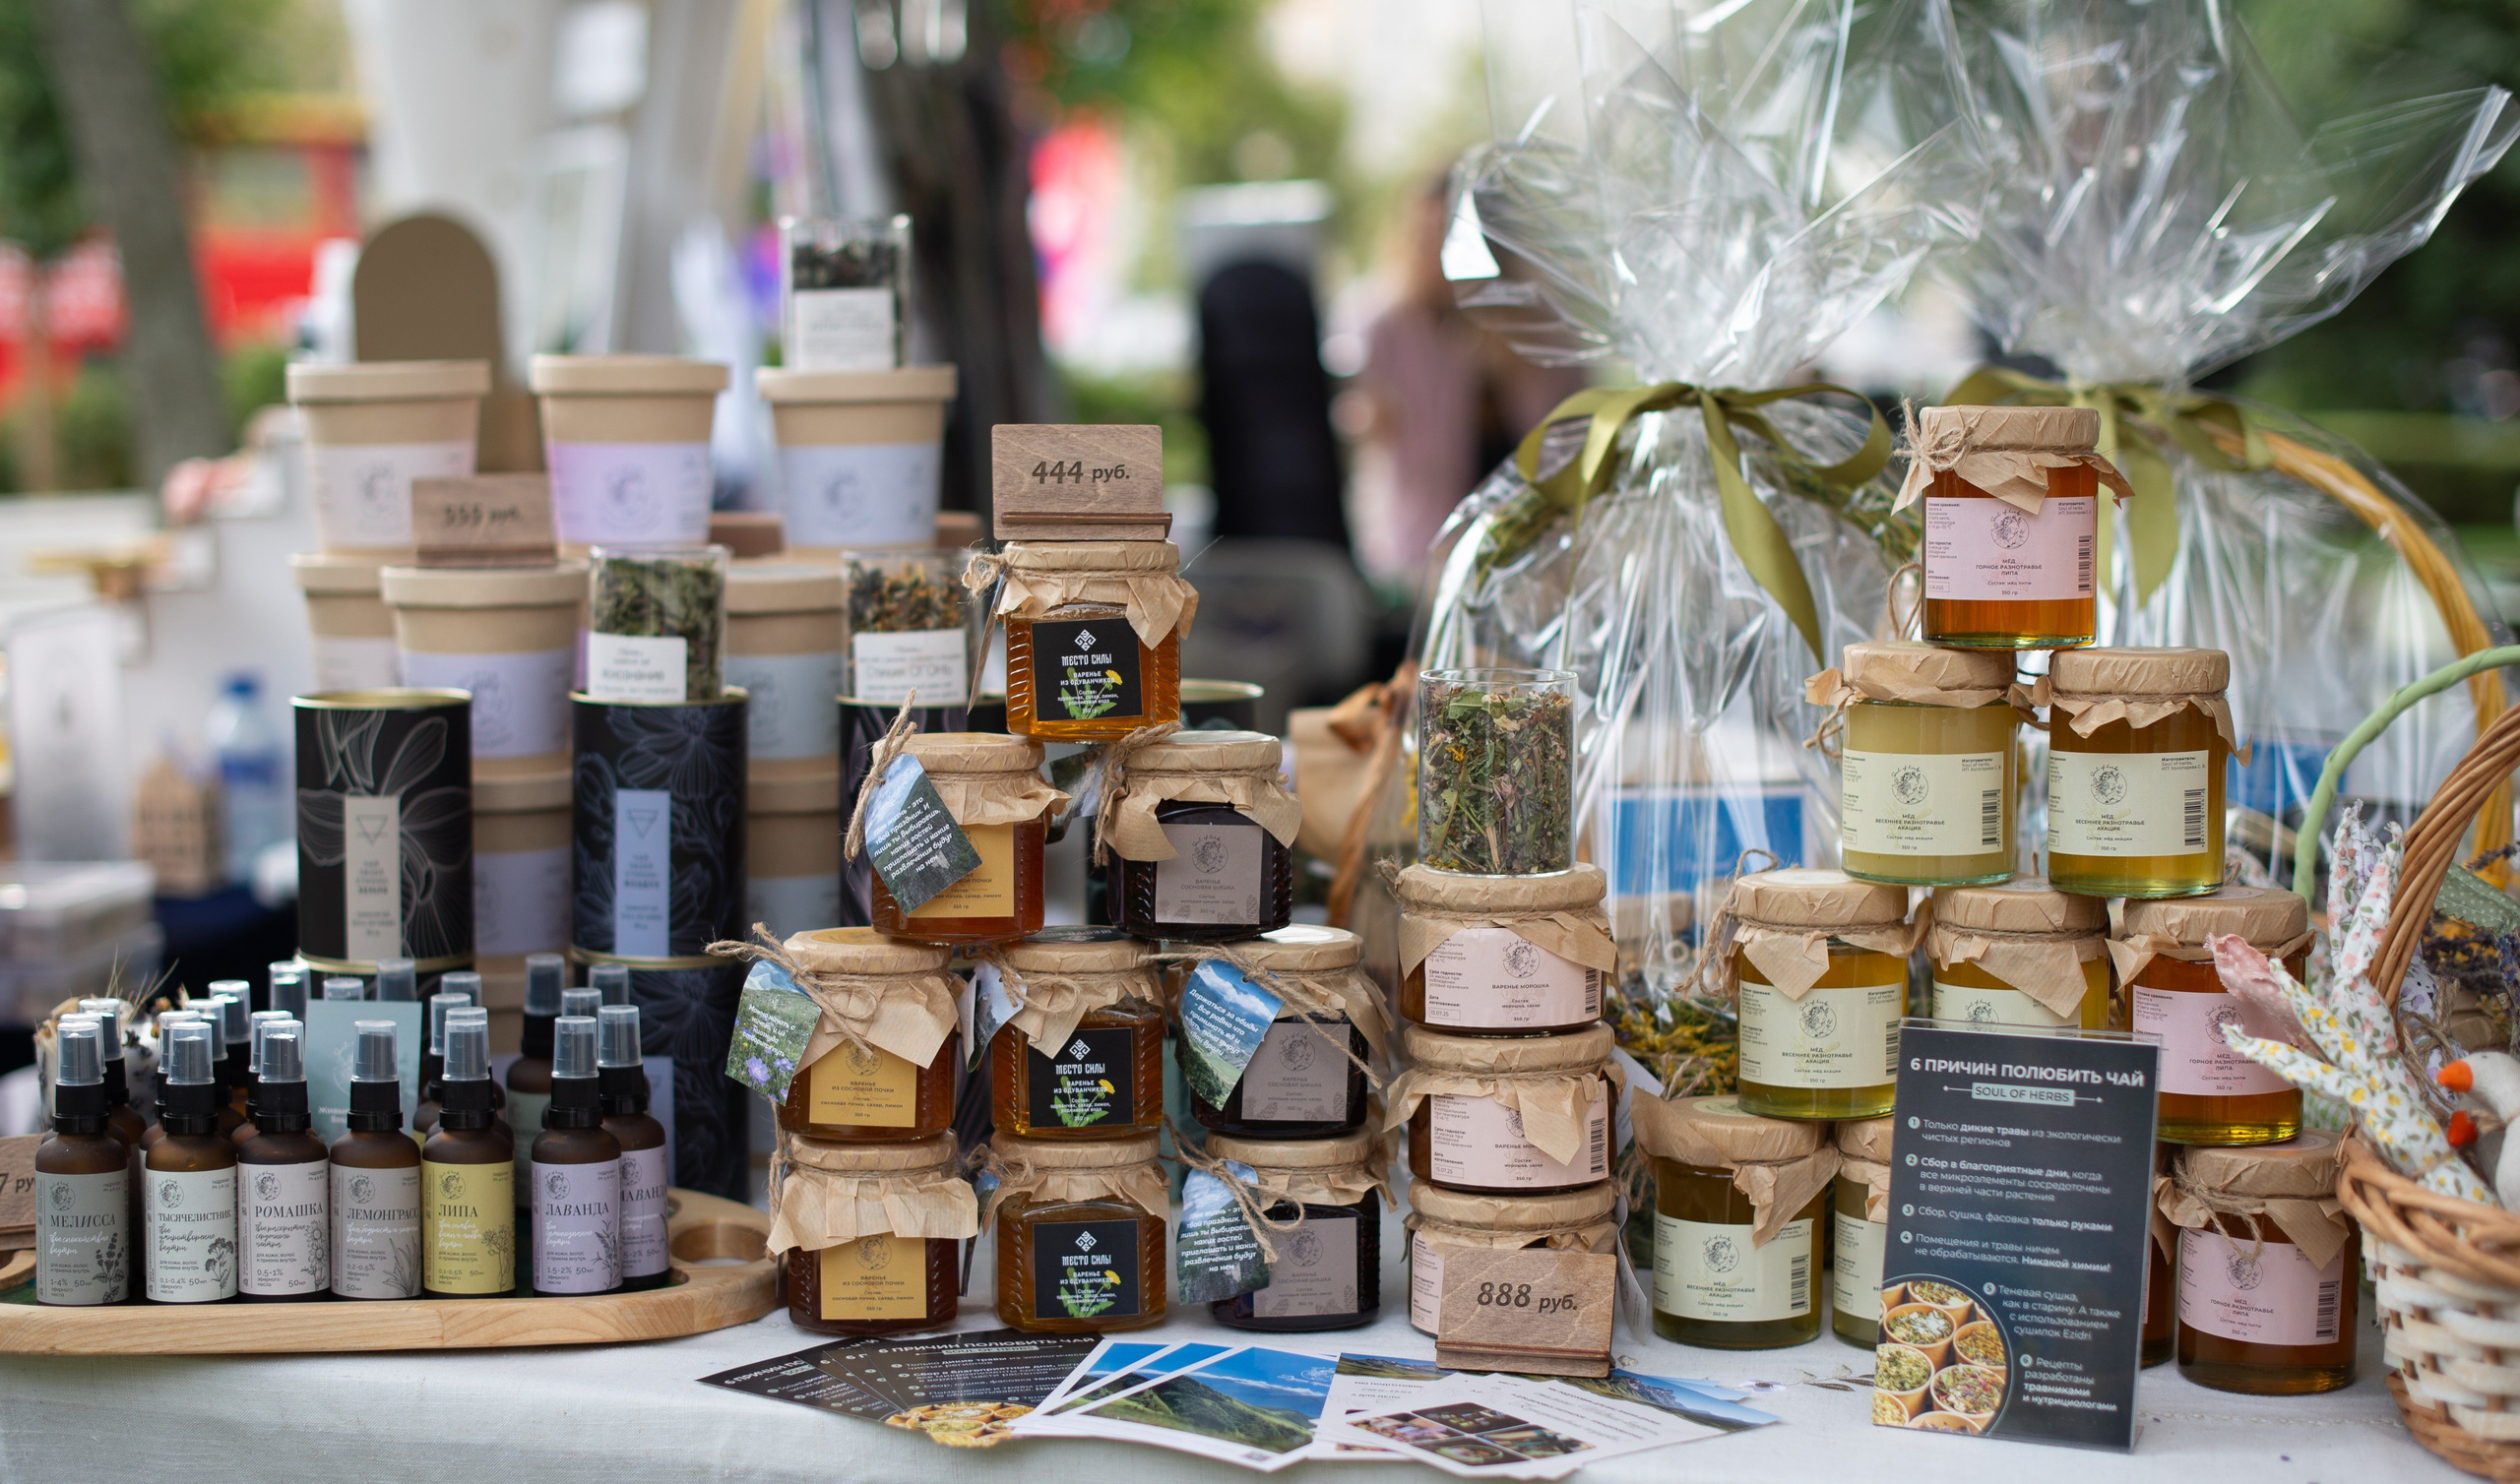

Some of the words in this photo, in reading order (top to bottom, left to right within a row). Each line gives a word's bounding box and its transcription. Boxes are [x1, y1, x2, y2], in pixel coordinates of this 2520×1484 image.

[1032, 461, 1083, 484] 444
[1092, 463, 1130, 483] руб.
[1061, 654, 1089, 666] МЕСТО
[1091, 653, 1112, 665] СИЛЫ
[1070, 677, 1115, 686] ОДУВАНЧИКОВ
[912, 796, 924, 808] это
[883, 842, 924, 872] приглашать
[929, 824, 950, 840] какие
[890, 839, 912, 856] каких
[911, 823, 933, 842] гостей
[874, 842, 892, 857] лишь
[890, 846, 933, 880] развлечения
[932, 833, 953, 849] будут
[915, 864, 925, 873] на
[1189, 988, 1227, 1015] Держаться
[1226, 1011, 1235, 1020] за
[1234, 1017, 1259, 1032] обиды
[1190, 1010, 1225, 1035] принимать
[1209, 1013, 1232, 1028] равно
[1232, 1025, 1245, 1035] что
[1055, 1064, 1083, 1075] МЕСТО
[1085, 1063, 1105, 1074] СИЛЫ
[1910, 1057, 1922, 1071] 6
[1924, 1058, 1997, 1077] ПРИЧИН
[2000, 1064, 2104, 1084] ПОЛЮБИТЬ
[2106, 1070, 2145, 1087] ЧАЙ
[1975, 1085, 2006, 1098] SOUL
[2009, 1088, 2026, 1099] OF
[2029, 1090, 2070, 1102] HERBS
[1922, 1119, 1959, 1131] Только
[1960, 1124, 1994, 1134] дикие
[1996, 1126, 2030, 1137] травы
[2047, 1131, 2121, 1144] экологически
[1922, 1133, 1959, 1143] чистых
[1960, 1136, 2011, 1147] регионов
[1921, 1156, 1949, 1169] Сбор
[1959, 1159, 2044, 1176] благоприятные
[2045, 1168, 2070, 1179] дни,
[2071, 1171, 2103, 1181] когда
[15, 1177, 35, 1194] ру
[1920, 1171, 1938, 1180] все
[1940, 1172, 2026, 1187] микроэлементы
[2028, 1180, 2110, 1194] сосредоточены
[1927, 1184, 1972, 1195] верхней
[1973, 1188, 2003, 1198] части
[2005, 1191, 2056, 1202] растения
[158, 1209, 231, 1222] ТЫСЯЧЕЛИСТНИК
[255, 1203, 324, 1218] РОМАШКА
[346, 1206, 419, 1220] ЛЕМОНГРАСС
[438, 1204, 478, 1217] ЛИПА
[545, 1202, 609, 1216] ЛАВАНДА
[50, 1213, 116, 1228] МЕЛИССА
[1918, 1206, 1947, 1218] Сбор,
[1949, 1209, 1984, 1221] сушка,
[1985, 1211, 2030, 1225] фасовка
[2031, 1216, 2069, 1228] только
[2070, 1220, 2113, 1232] руками
[1916, 1233, 1980, 1247] Помещения
[1990, 1241, 2023, 1252] травы
[2025, 1245, 2060, 1255] ничем
[1061, 1255, 1089, 1267] МЕСТО
[1091, 1254, 1112, 1265] СИЛЫ
[1915, 1247, 1928, 1256] не
[1929, 1247, 2019, 1264] обрабатываются.
[2021, 1255, 2069, 1268] Никакой
[2070, 1261, 2111, 1272] химии!
[1477, 1281, 1532, 1308] 888
[1538, 1293, 1578, 1314] руб.
[1998, 1284, 2043, 1298] Теневая
[2043, 1290, 2079, 1303] сушка,
[2002, 1299, 2020, 1309] как
[2022, 1301, 2030, 1310] в
[2031, 1302, 2076, 1316] старину.
[2077, 1305, 2088, 1315] А
[2088, 1308, 2121, 1319] также
[2018, 1313, 2109, 1329] использованием
[2013, 1326, 2061, 1337] сушилок
[2062, 1329, 2093, 1340] Ezidri
[892, 1342, 961, 1353] ПРИЧИН
[964, 1339, 1057, 1349] ПОЛЮБИТЬ
[1060, 1336, 1096, 1345] ЧАЙ
[2036, 1356, 2083, 1372] Рецепты
[2024, 1370, 2096, 1386] разработаны
[2023, 1382, 2091, 1397] травниками
[2031, 1395, 2117, 1412] нутрициологами
